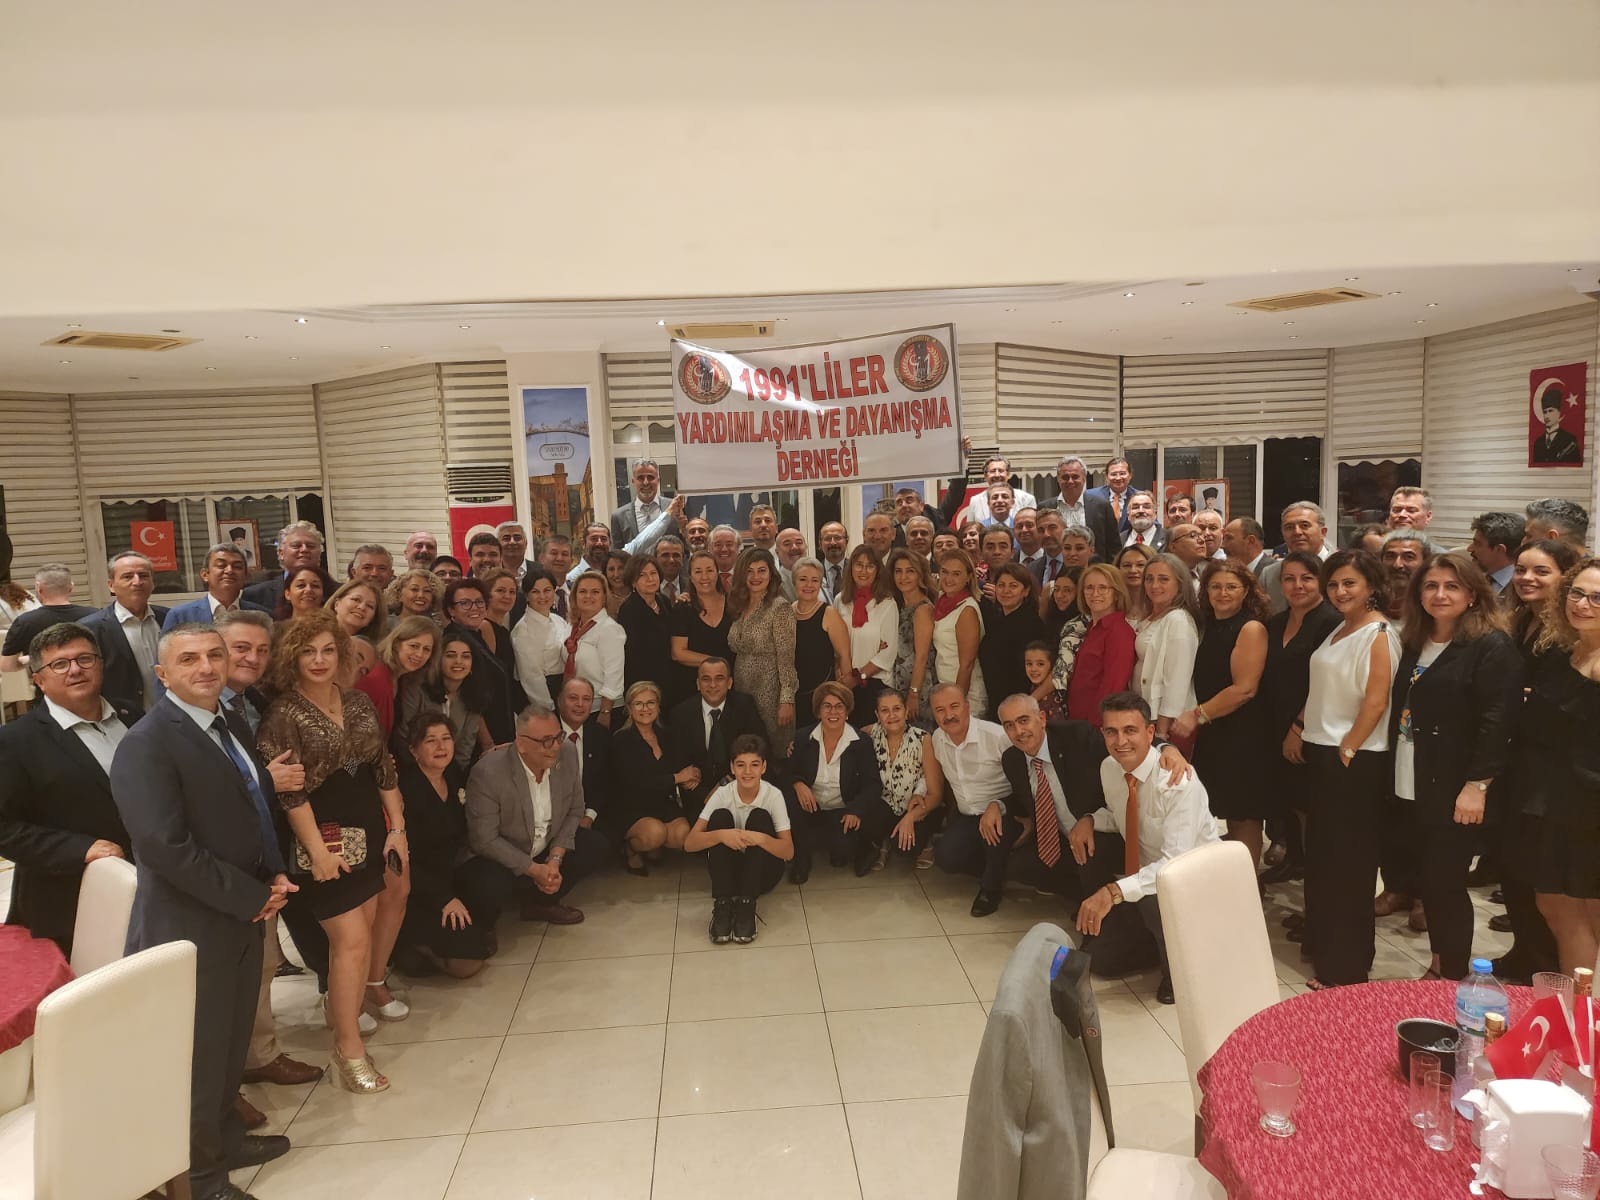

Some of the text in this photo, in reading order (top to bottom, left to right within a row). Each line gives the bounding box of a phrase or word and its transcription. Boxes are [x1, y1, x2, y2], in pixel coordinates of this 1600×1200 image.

[740, 352, 889, 401] 1991'LİLER
[677, 396, 952, 449] YARDIMLAŞMA VE DAYANIŞMA
[777, 439, 859, 482] DERNEĞİ
